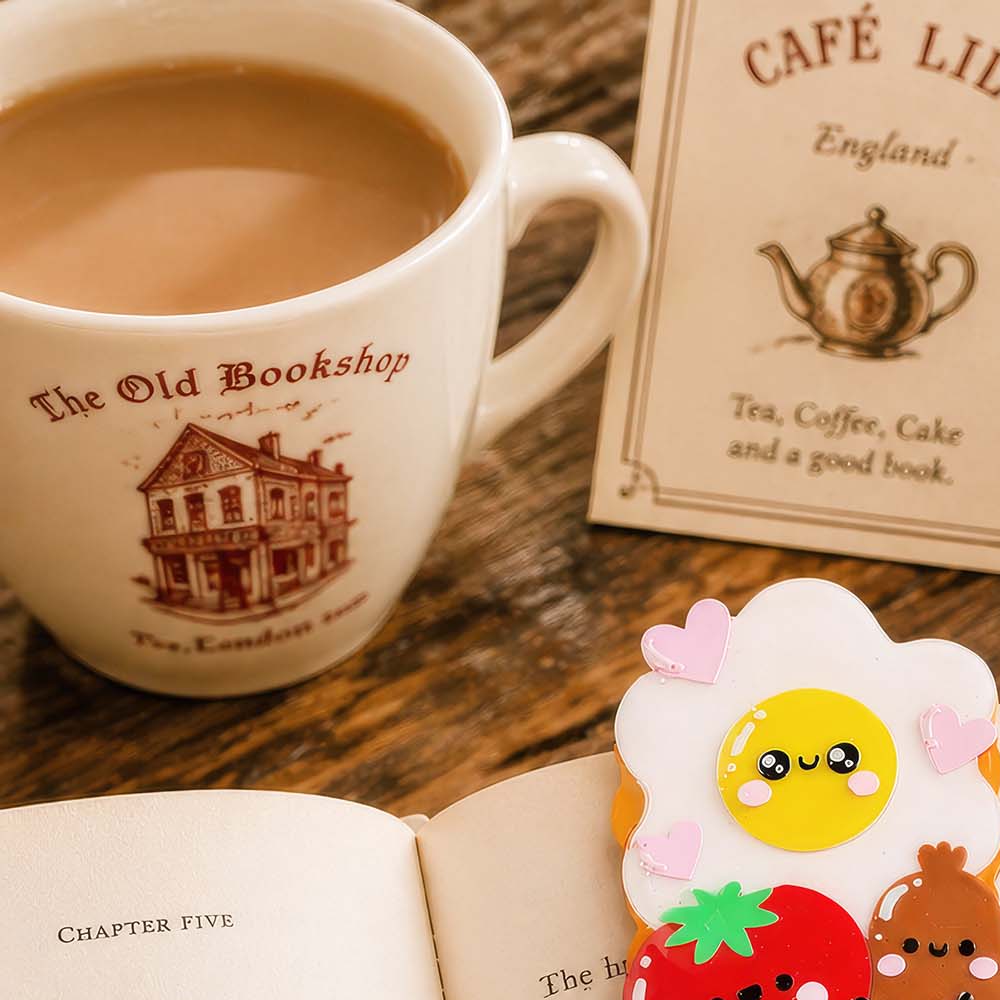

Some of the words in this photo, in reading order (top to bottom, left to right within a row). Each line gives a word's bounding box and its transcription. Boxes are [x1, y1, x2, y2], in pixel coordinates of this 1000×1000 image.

[744, 4, 880, 88] CAFÉ
[813, 122, 958, 171] England
[30, 385, 106, 423] The
[116, 368, 201, 403] Old
[217, 341, 411, 396] Bookshop
[728, 393, 784, 427] Tea,
[795, 401, 885, 442] Coffee,
[895, 414, 964, 446] Cake
[728, 438, 777, 464] and
[786, 450, 800, 466] a
[808, 446, 873, 476] good
[882, 452, 954, 486] book.
